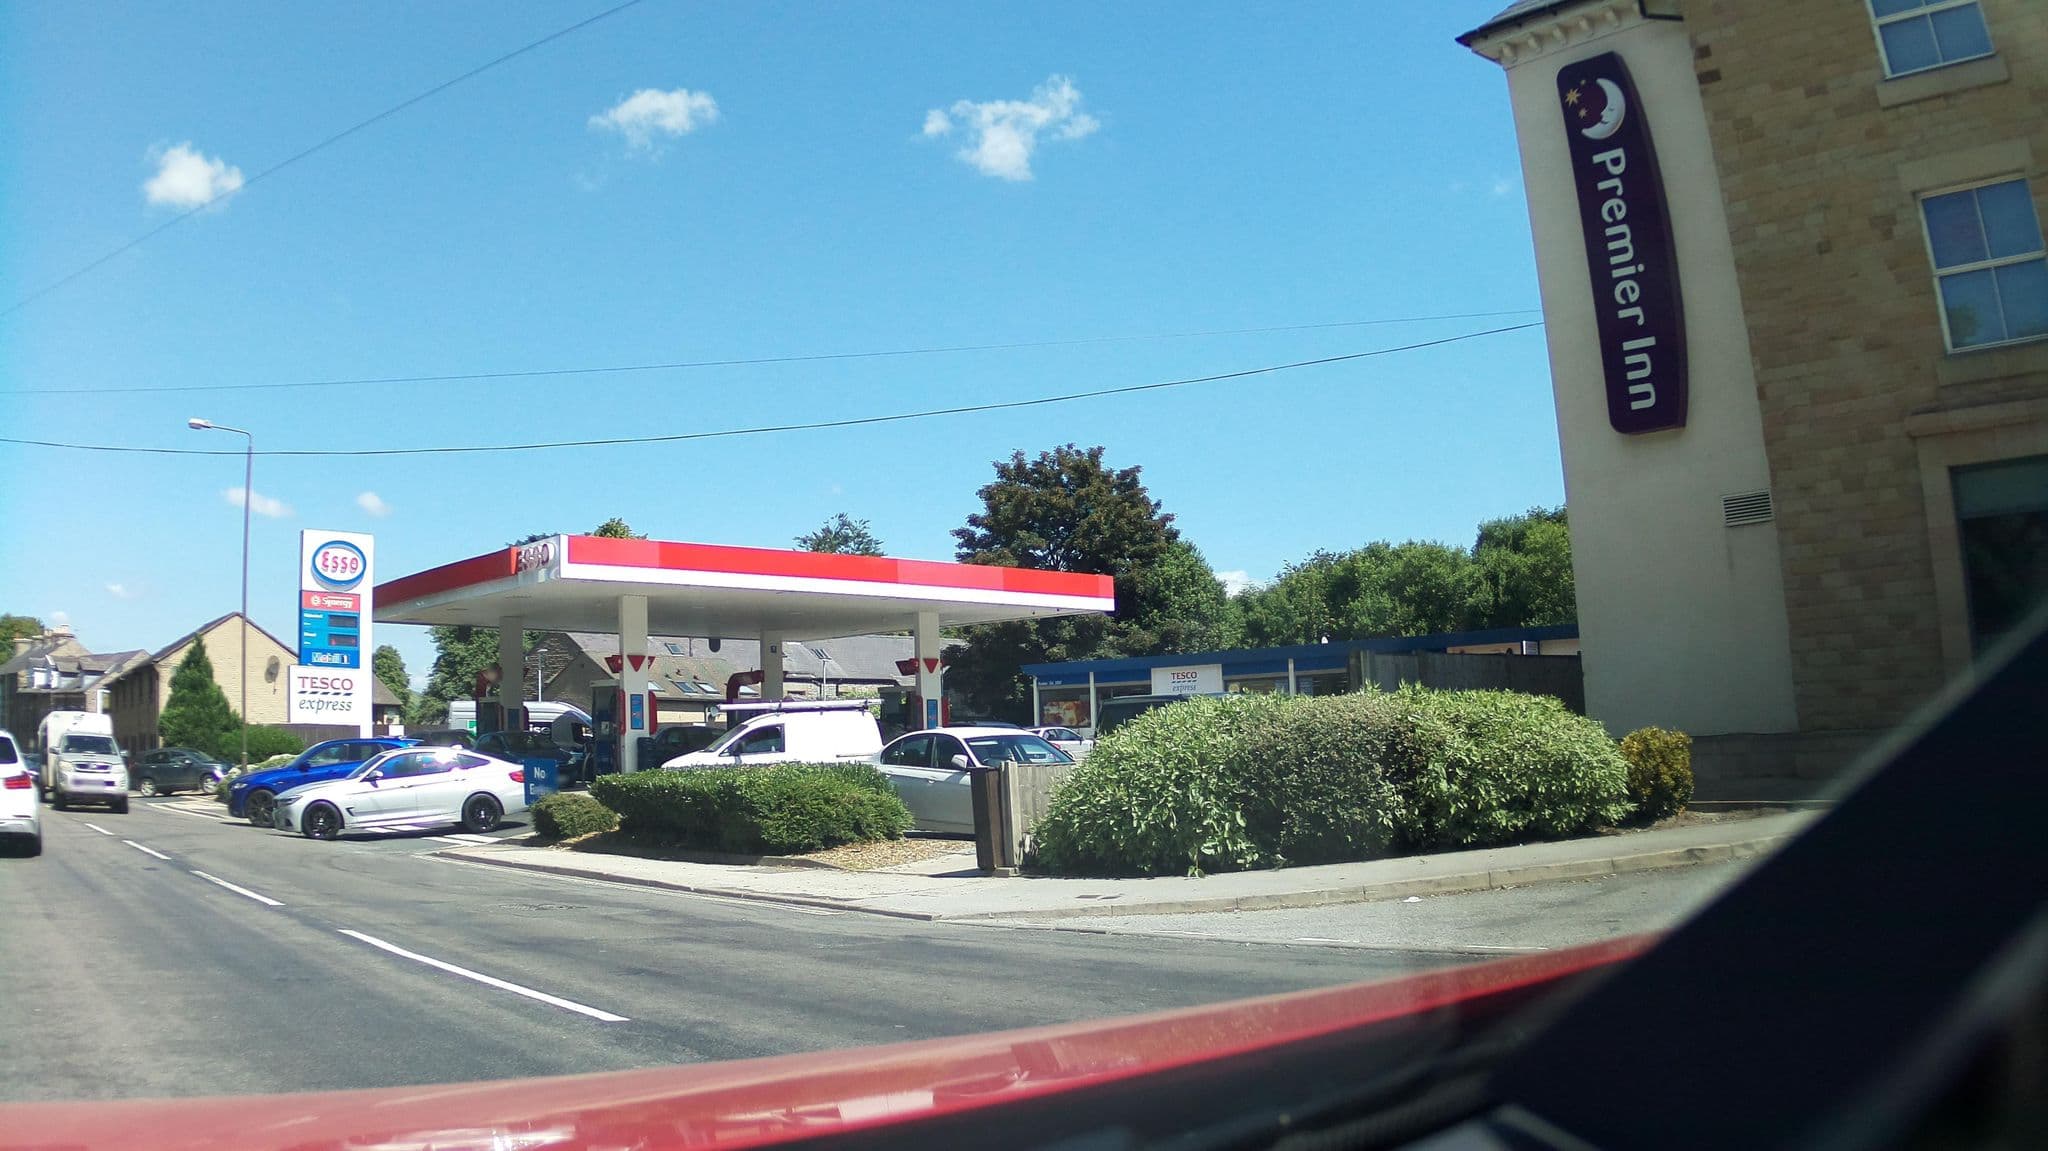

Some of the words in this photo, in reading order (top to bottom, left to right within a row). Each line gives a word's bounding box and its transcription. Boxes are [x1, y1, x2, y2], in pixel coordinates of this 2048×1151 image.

[1592, 147, 1645, 326] Premier
[1622, 336, 1656, 410] Inn
[321, 595, 353, 608] Synergy
[1171, 671, 1197, 680] TESCO
[298, 676, 353, 691] TESCO
[1172, 684, 1197, 693] express
[299, 698, 352, 713] express
[534, 767, 546, 779] No
